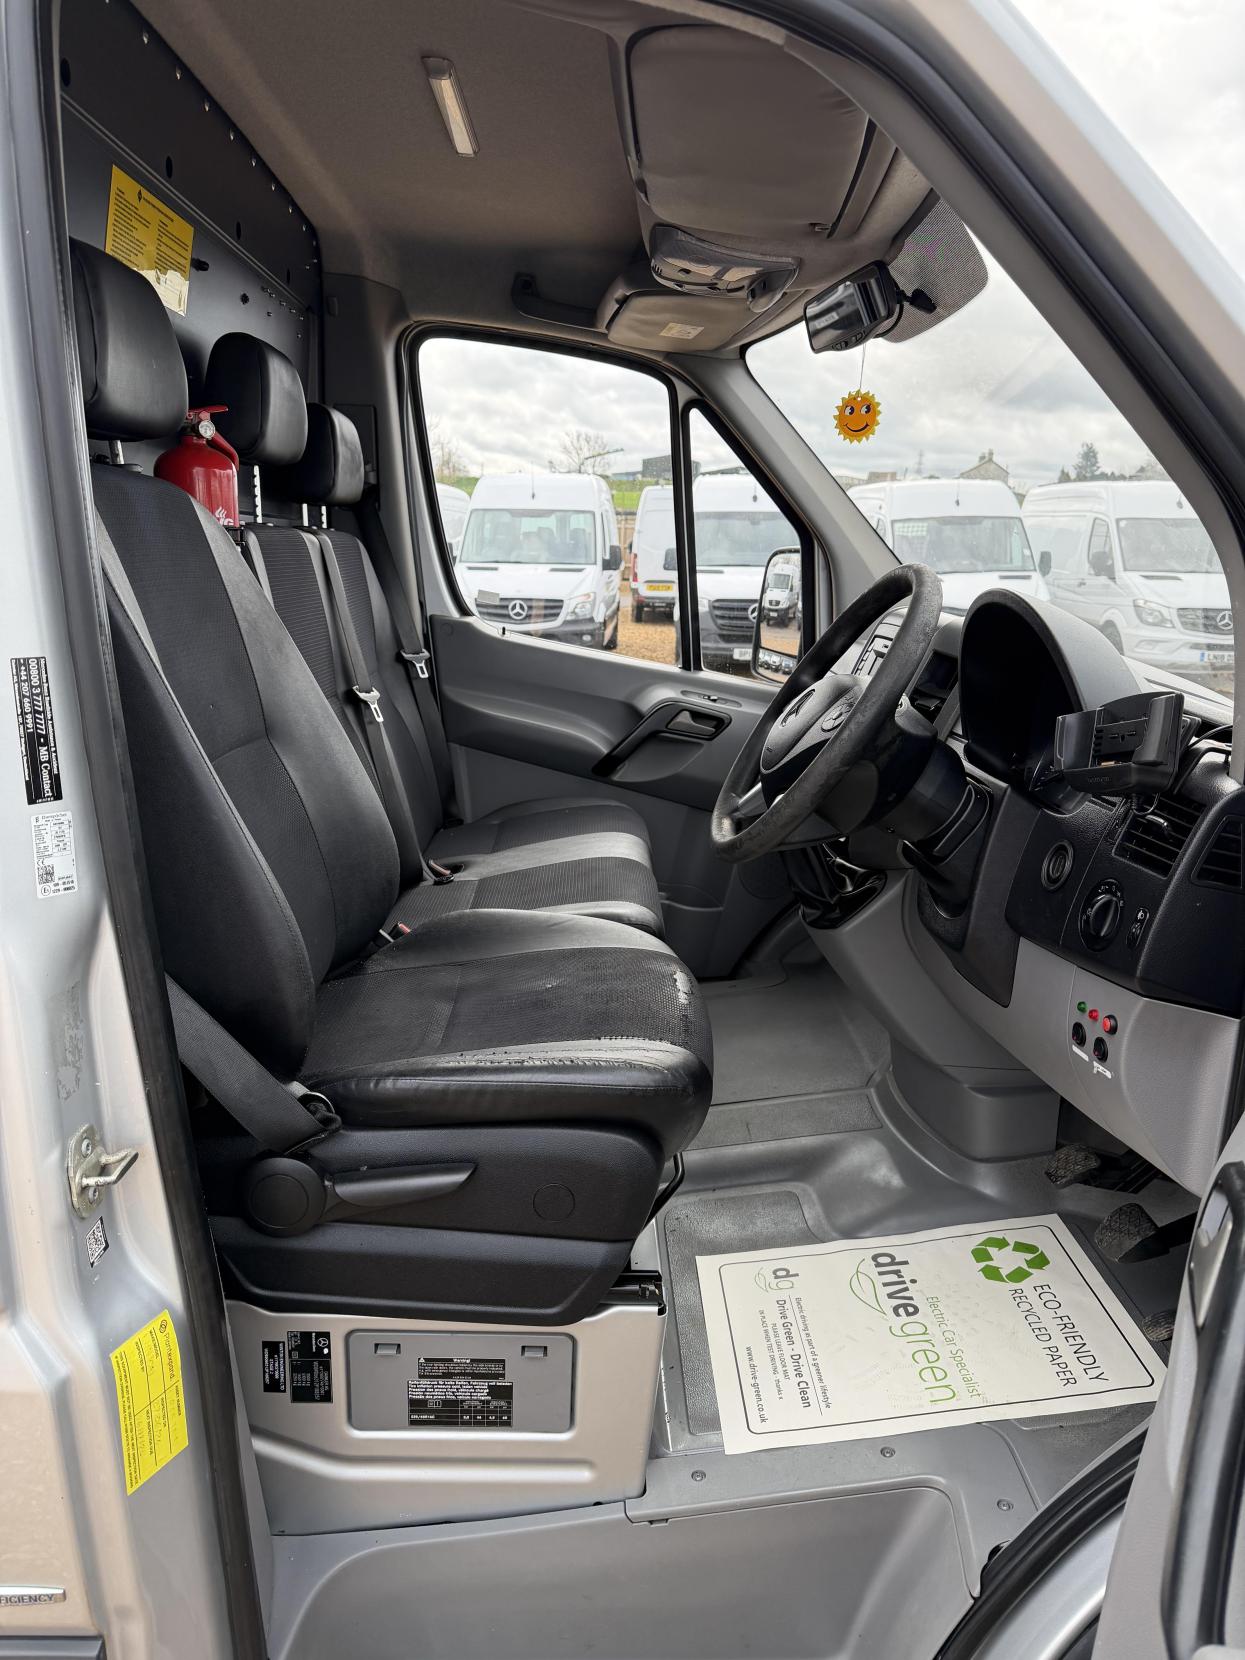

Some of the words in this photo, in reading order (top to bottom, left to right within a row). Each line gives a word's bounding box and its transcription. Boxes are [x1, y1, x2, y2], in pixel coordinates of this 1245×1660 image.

[19, 665, 27, 680] +44
[28, 658, 39, 685] 00800
[20, 681, 29, 696] 207
[22, 697, 31, 712] 660
[32, 694, 42, 711] 777
[24, 713, 33, 732] 9991
[34, 712, 45, 735] 7777
[38, 745, 49, 761] MB
[40, 762, 53, 797] Contact
[770, 1322, 779, 1338] PLEASE
[1009, 1288, 1052, 1342] RECYCLED
[1042, 1345, 1077, 1386] PAPER
[1033, 1284, 1109, 1381] ECO-FRIENDLY
[774, 1338, 783, 1352] LEAVE
[776, 1299, 788, 1320] Drive
[782, 1322, 794, 1346] Green
[791, 1354, 804, 1378] Drive
[798, 1380, 811, 1408] Clean
[926, 1296, 949, 1328] Electric
[942, 1330, 957, 1346] Car
[950, 1348, 981, 1398] Specialist
[762, 1328, 771, 1343] WHEN
[768, 1354, 779, 1375] DRIVING
[774, 1378, 784, 1395] thanks
[777, 1352, 787, 1368] FLOOR
[800, 1314, 808, 1333] driving
[812, 1365, 824, 1384] greener
[820, 1384, 830, 1408] lifestyle
[782, 1368, 790, 1380] MAT
[746, 1346, 768, 1424] www.drive-green.co.uk
